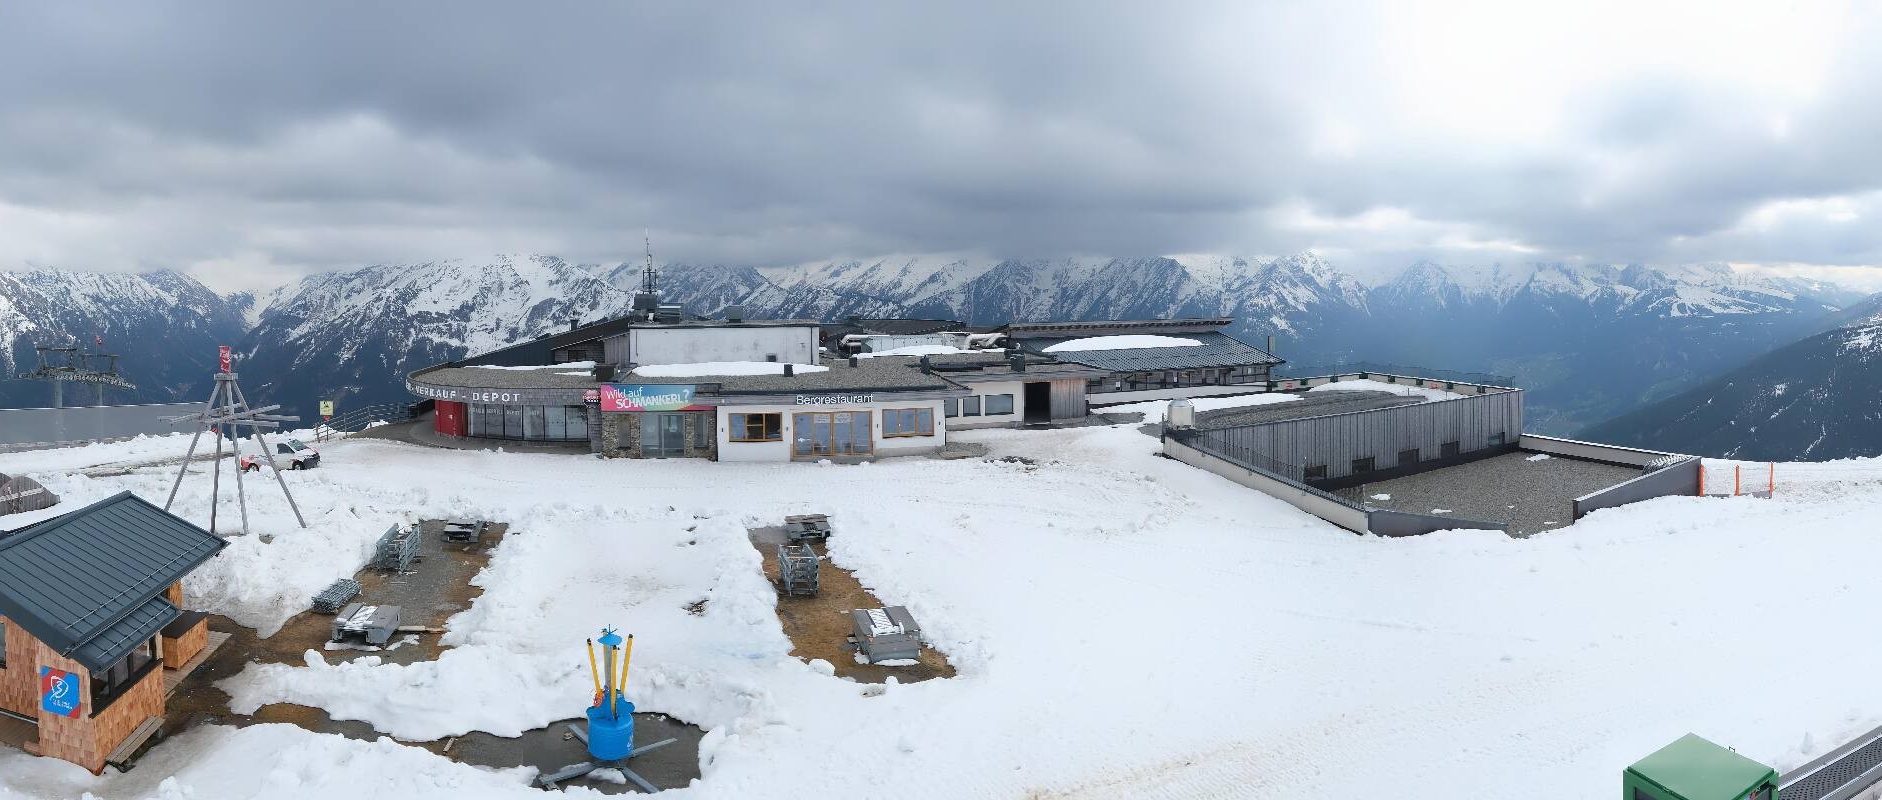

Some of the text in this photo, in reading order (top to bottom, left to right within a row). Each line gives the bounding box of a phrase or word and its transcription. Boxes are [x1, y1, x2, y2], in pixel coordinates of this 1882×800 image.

[415, 386, 521, 402] VERKAUF DEPOT
[627, 386, 643, 398] auf
[796, 394, 874, 406] Bergrestaurant
